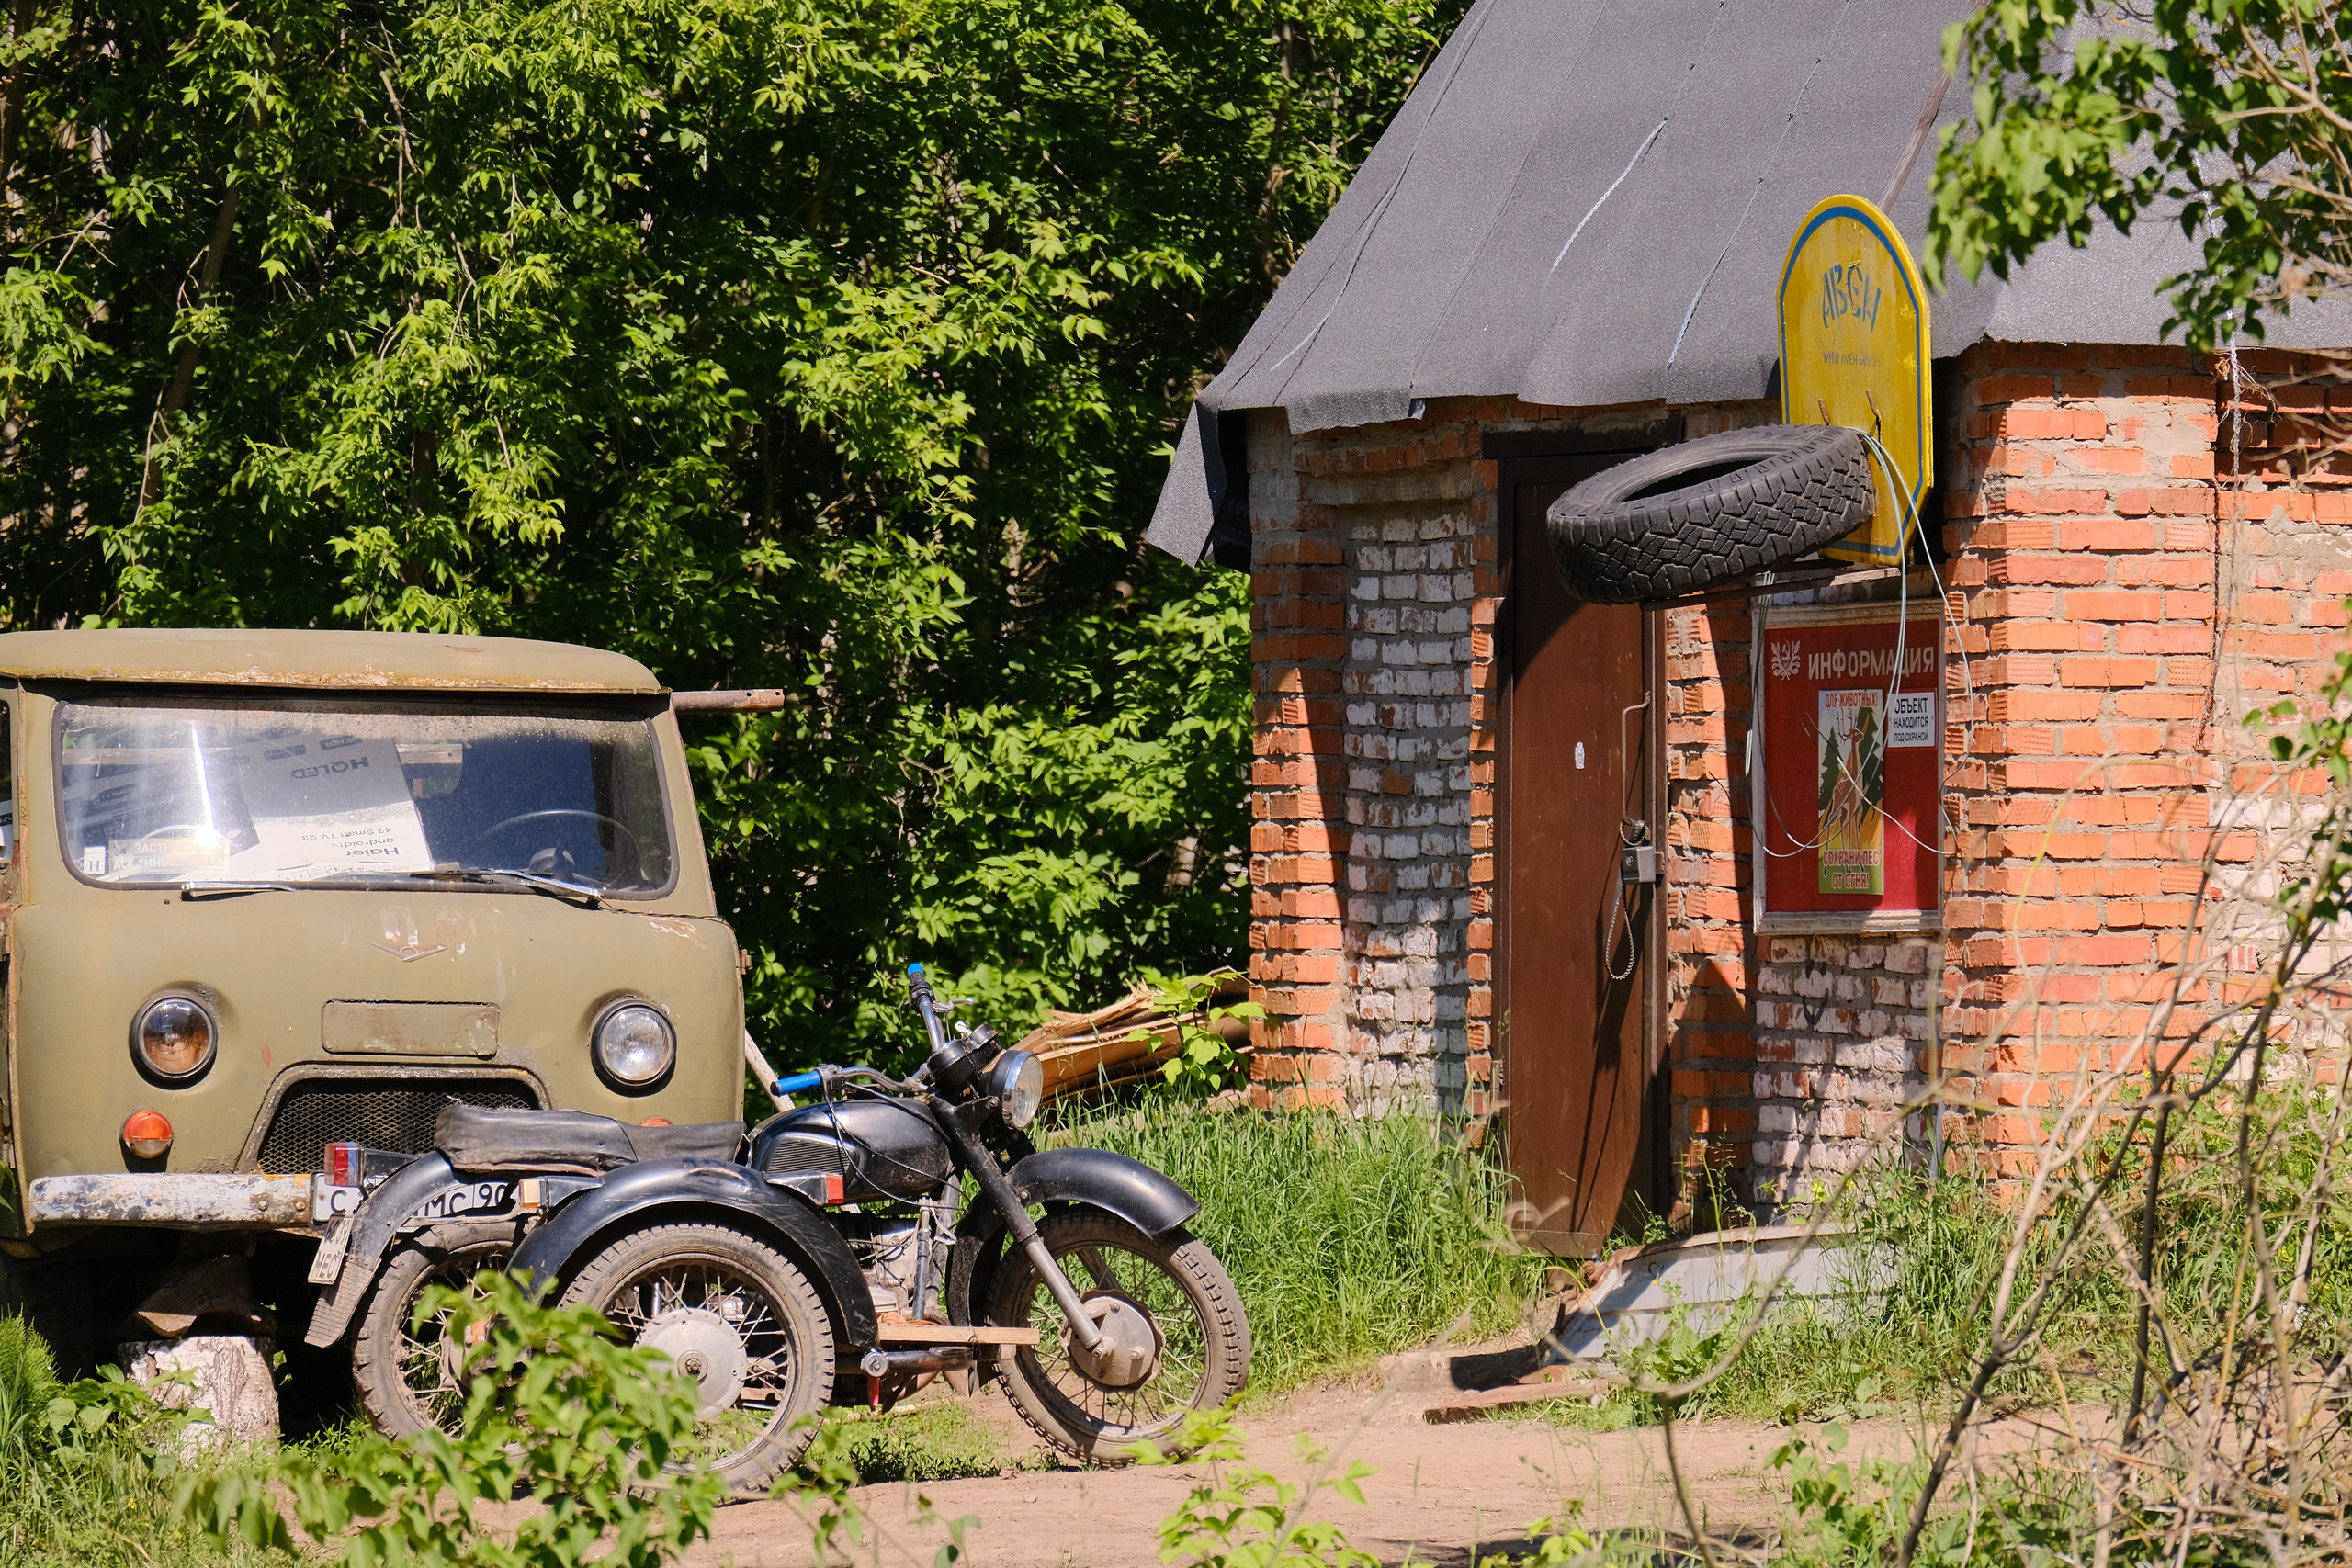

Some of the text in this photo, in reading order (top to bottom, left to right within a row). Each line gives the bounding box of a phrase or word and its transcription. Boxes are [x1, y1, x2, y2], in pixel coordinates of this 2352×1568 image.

[1808, 646, 1935, 680] ИНФОРМАЦИЯ
[1826, 692, 1878, 709] ДЛЯ ЖИВОТНЫХ!
[1894, 697, 1928, 714] ОБЪЕКТ
[1894, 716, 1928, 729] НАХОДИТСЯ
[1894, 730, 1928, 743] ПОД ОХРАНОЙ
[290, 756, 370, 779] HQLED
[340, 829, 375, 838] Smart
[378, 827, 392, 835] 43
[346, 847, 400, 857] Haier
[1823, 850, 1880, 865] СОХРАНИ ЛЕС
[1832, 873, 1870, 889] ОТ ОГНЯ!
